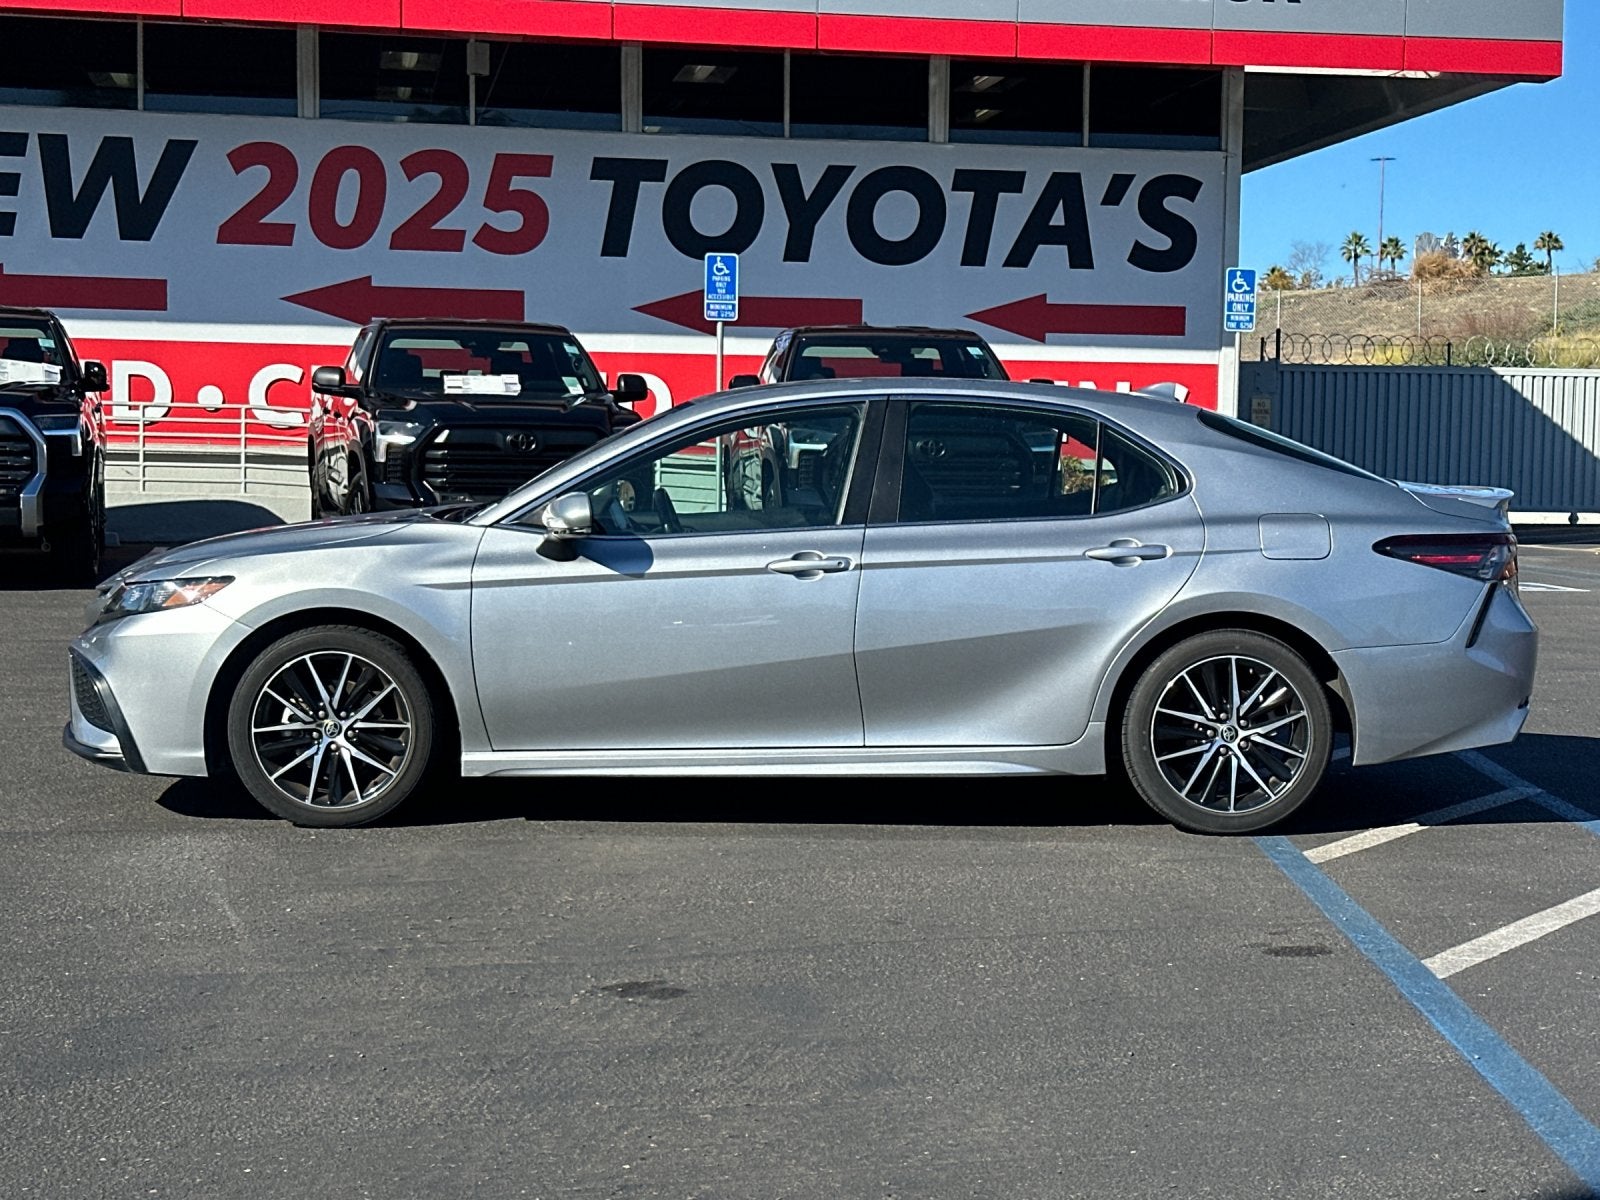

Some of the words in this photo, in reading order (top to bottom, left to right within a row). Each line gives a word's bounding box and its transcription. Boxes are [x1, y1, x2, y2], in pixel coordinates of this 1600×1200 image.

[216, 141, 555, 255] 2025
[590, 156, 1204, 272] TOYOTA'S
[1227, 292, 1255, 303] PARKING
[1232, 302, 1250, 312] ONLY
